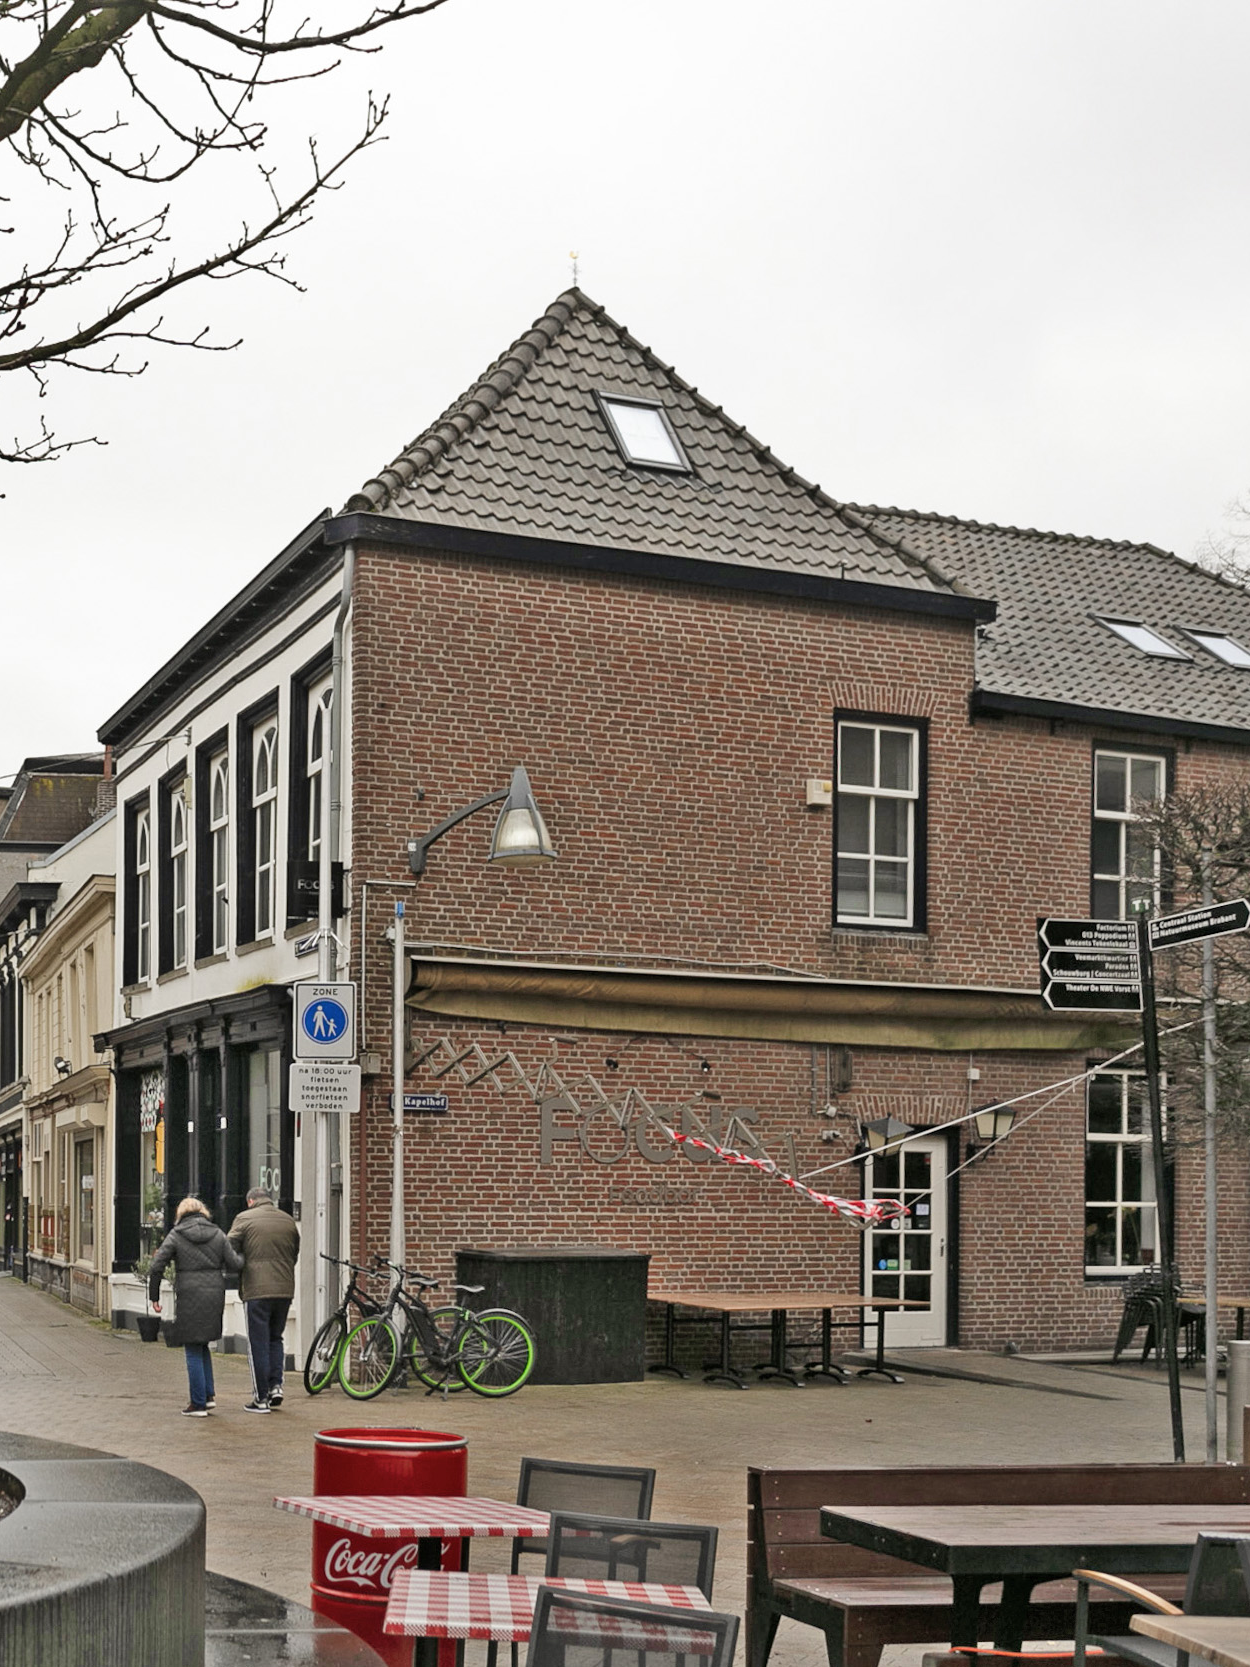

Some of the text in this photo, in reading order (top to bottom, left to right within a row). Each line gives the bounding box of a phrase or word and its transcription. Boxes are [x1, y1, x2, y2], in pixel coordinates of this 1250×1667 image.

[298, 879, 335, 890] FOCS
[1159, 911, 1212, 929] Centraal Station
[1096, 923, 1127, 931] Factorium
[1160, 913, 1236, 937] Natuurmuseum Brabant
[1094, 932, 1127, 940] Poppodium
[1064, 938, 1092, 946] Vincents
[1094, 970, 1130, 978] Concertzaal
[312, 988, 338, 996] ZONE
[1065, 983, 1089, 991] Theater
[1114, 985, 1131, 993] Vorst
[311, 1067, 335, 1075] 18:00
[302, 1085, 347, 1093] toegestaan
[404, 1097, 446, 1108] Kapelhof
[609, 1182, 700, 1204] Foodbar
[325, 1538, 451, 1589] Coca-C
